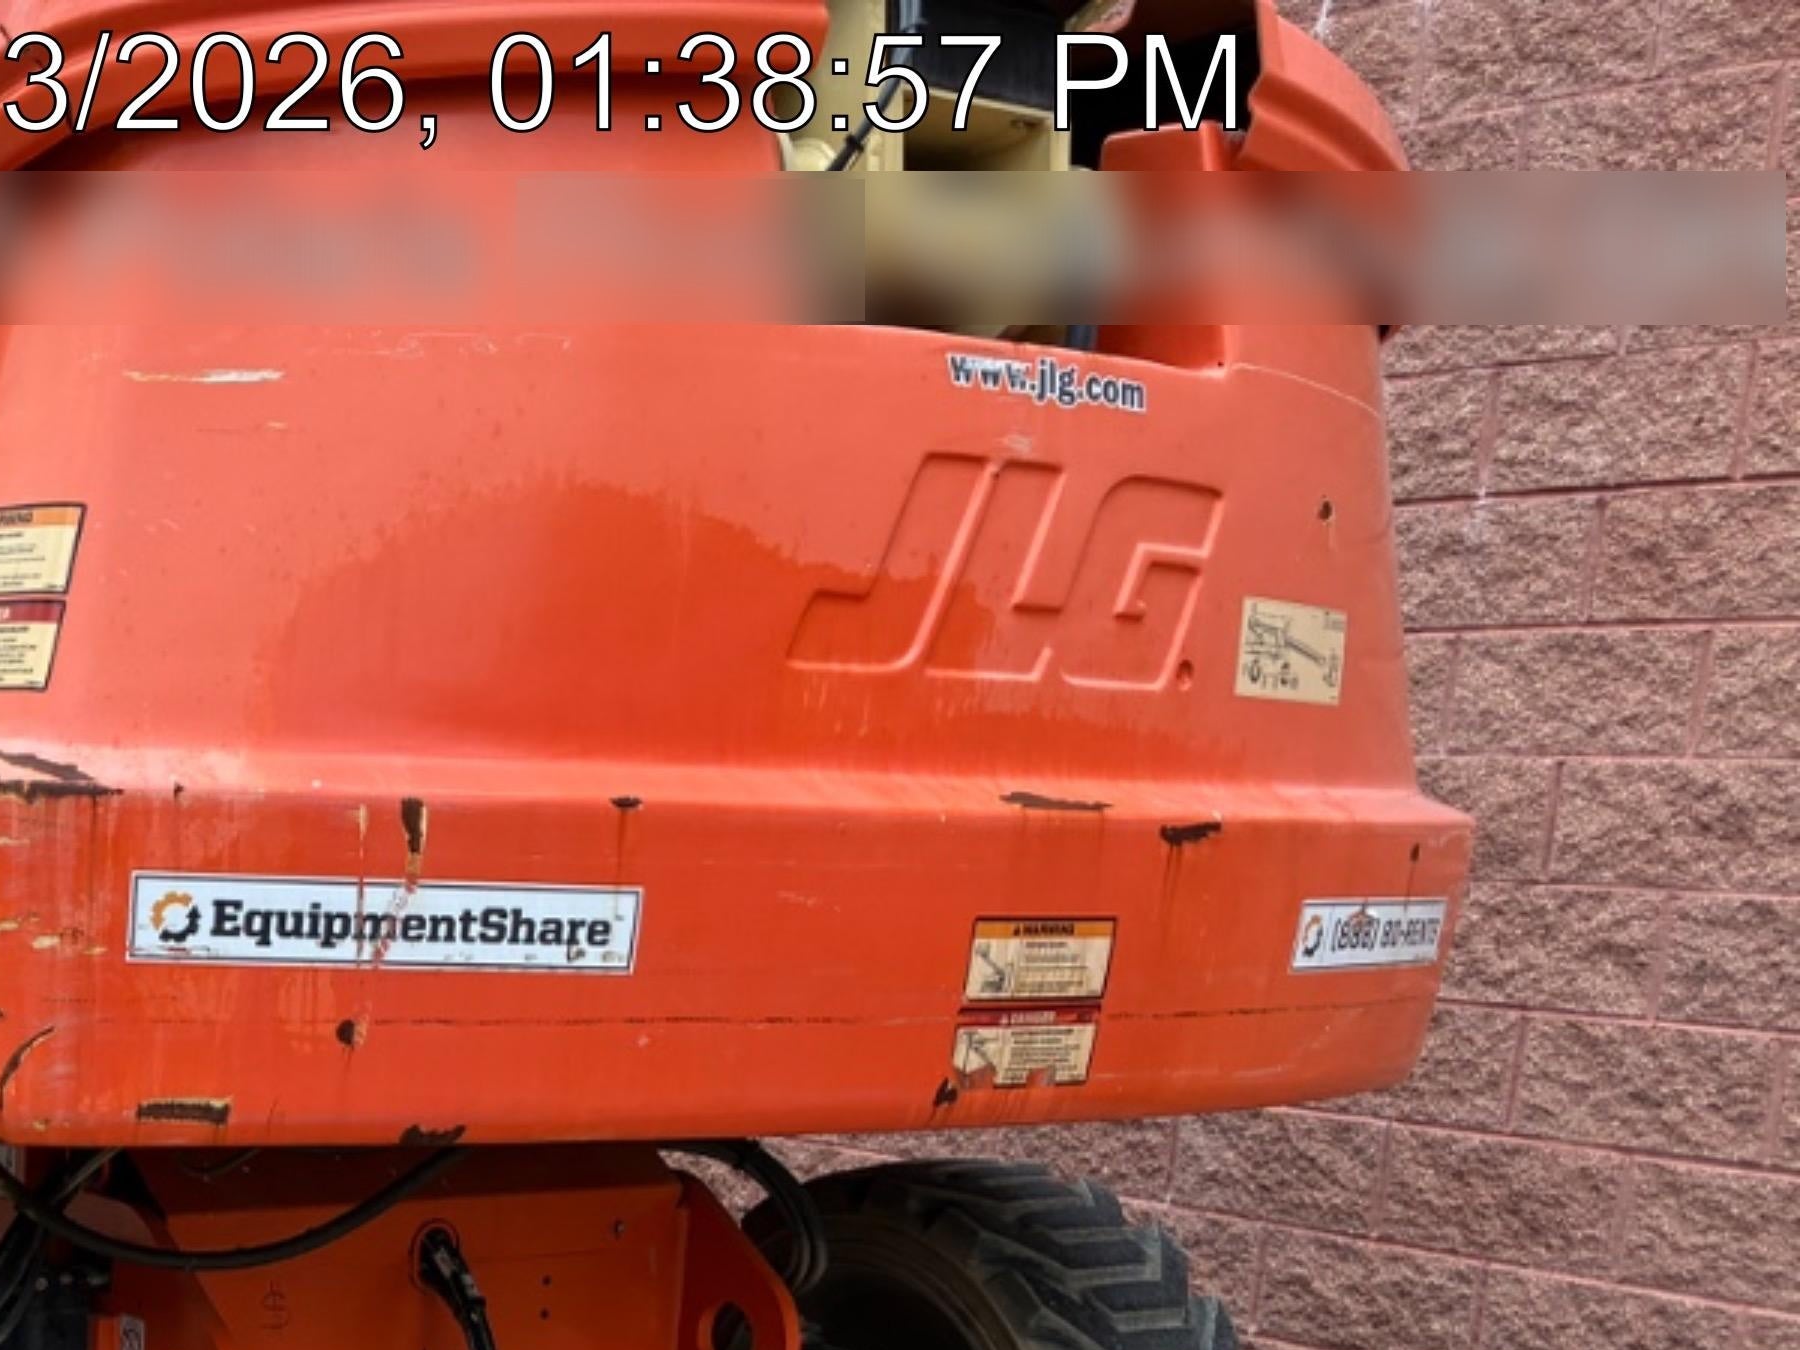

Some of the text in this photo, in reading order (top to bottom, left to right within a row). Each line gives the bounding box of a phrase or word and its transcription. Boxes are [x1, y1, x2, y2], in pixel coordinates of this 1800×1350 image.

[951, 356, 1145, 408] www.jlg.com
[787, 451, 1225, 692] JLG
[210, 898, 612, 948] EquipmentShare
